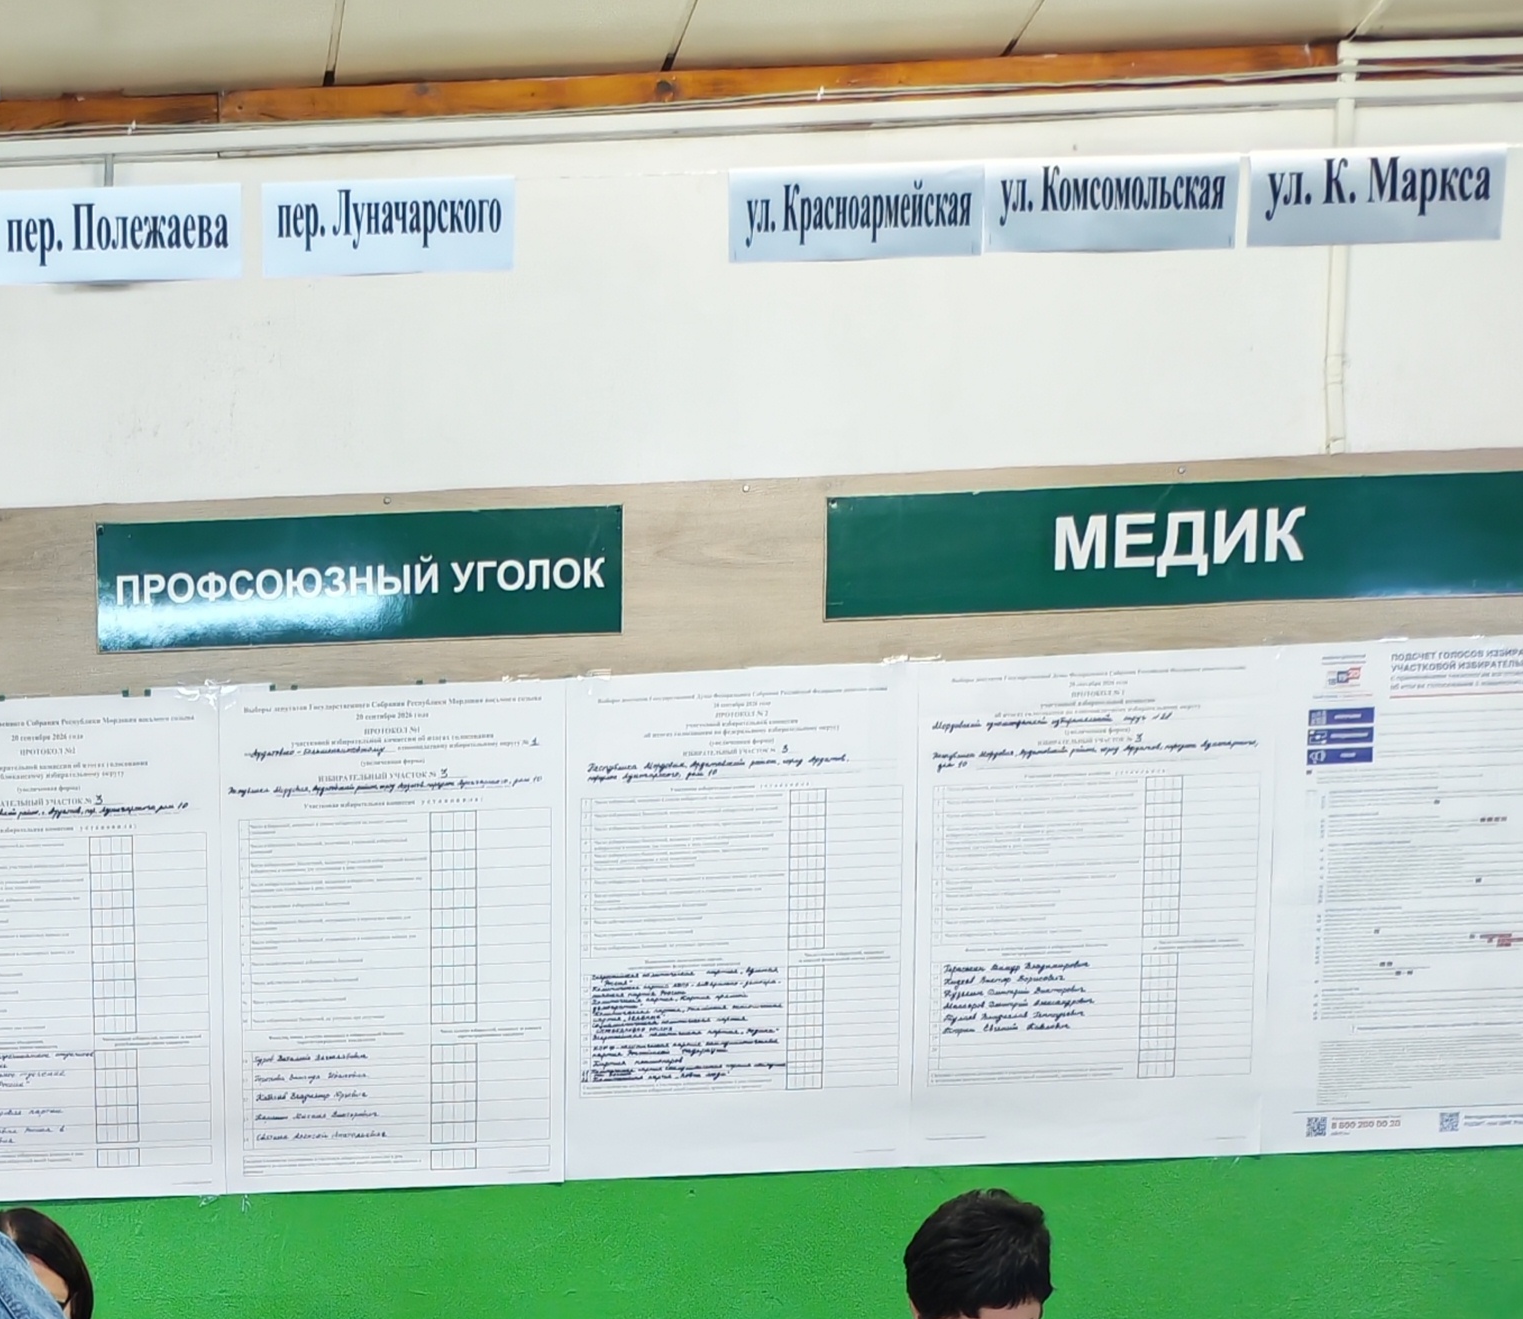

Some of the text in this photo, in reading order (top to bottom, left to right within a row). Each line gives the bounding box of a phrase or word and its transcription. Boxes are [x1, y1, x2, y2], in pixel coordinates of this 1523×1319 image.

[278, 189, 501, 251] пер. Луначарского
[745, 180, 971, 247] ул. Красноармейская
[999, 166, 1225, 226] ул. Комсомольская
[1265, 156, 1490, 221] ул. К. Маркса
[7, 203, 228, 266] пер. Полежаева
[1054, 505, 1306, 578] МЕДИК
[116, 555, 605, 605] ПРОФСОЮЗНЫЙ УГОЛОК
